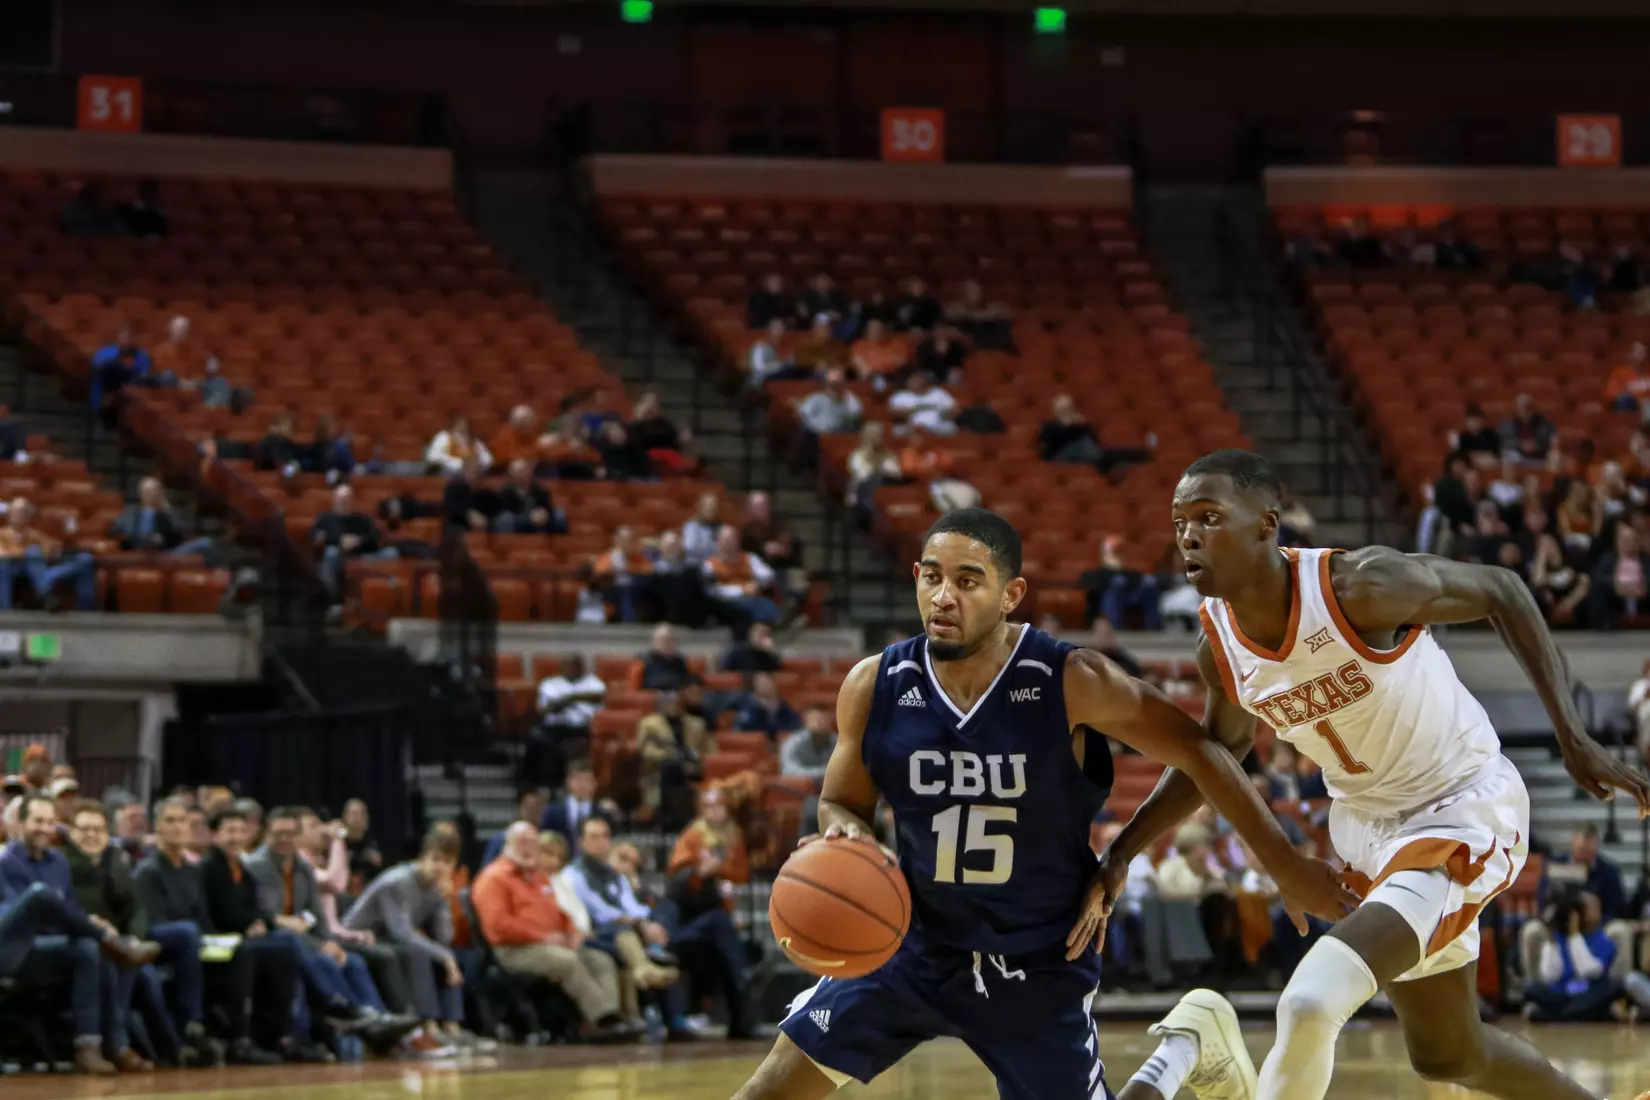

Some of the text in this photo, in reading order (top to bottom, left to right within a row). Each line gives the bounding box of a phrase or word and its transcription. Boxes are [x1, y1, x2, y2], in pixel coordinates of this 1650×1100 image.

[898, 697, 926, 708] adidas
[1009, 687, 1041, 703] WAC
[1249, 659, 1374, 728] TEXAS
[1313, 717, 1373, 775] 1
[909, 750, 1027, 799] CBU
[931, 804, 1018, 885] 15
[809, 1010, 830, 1034] adidas
